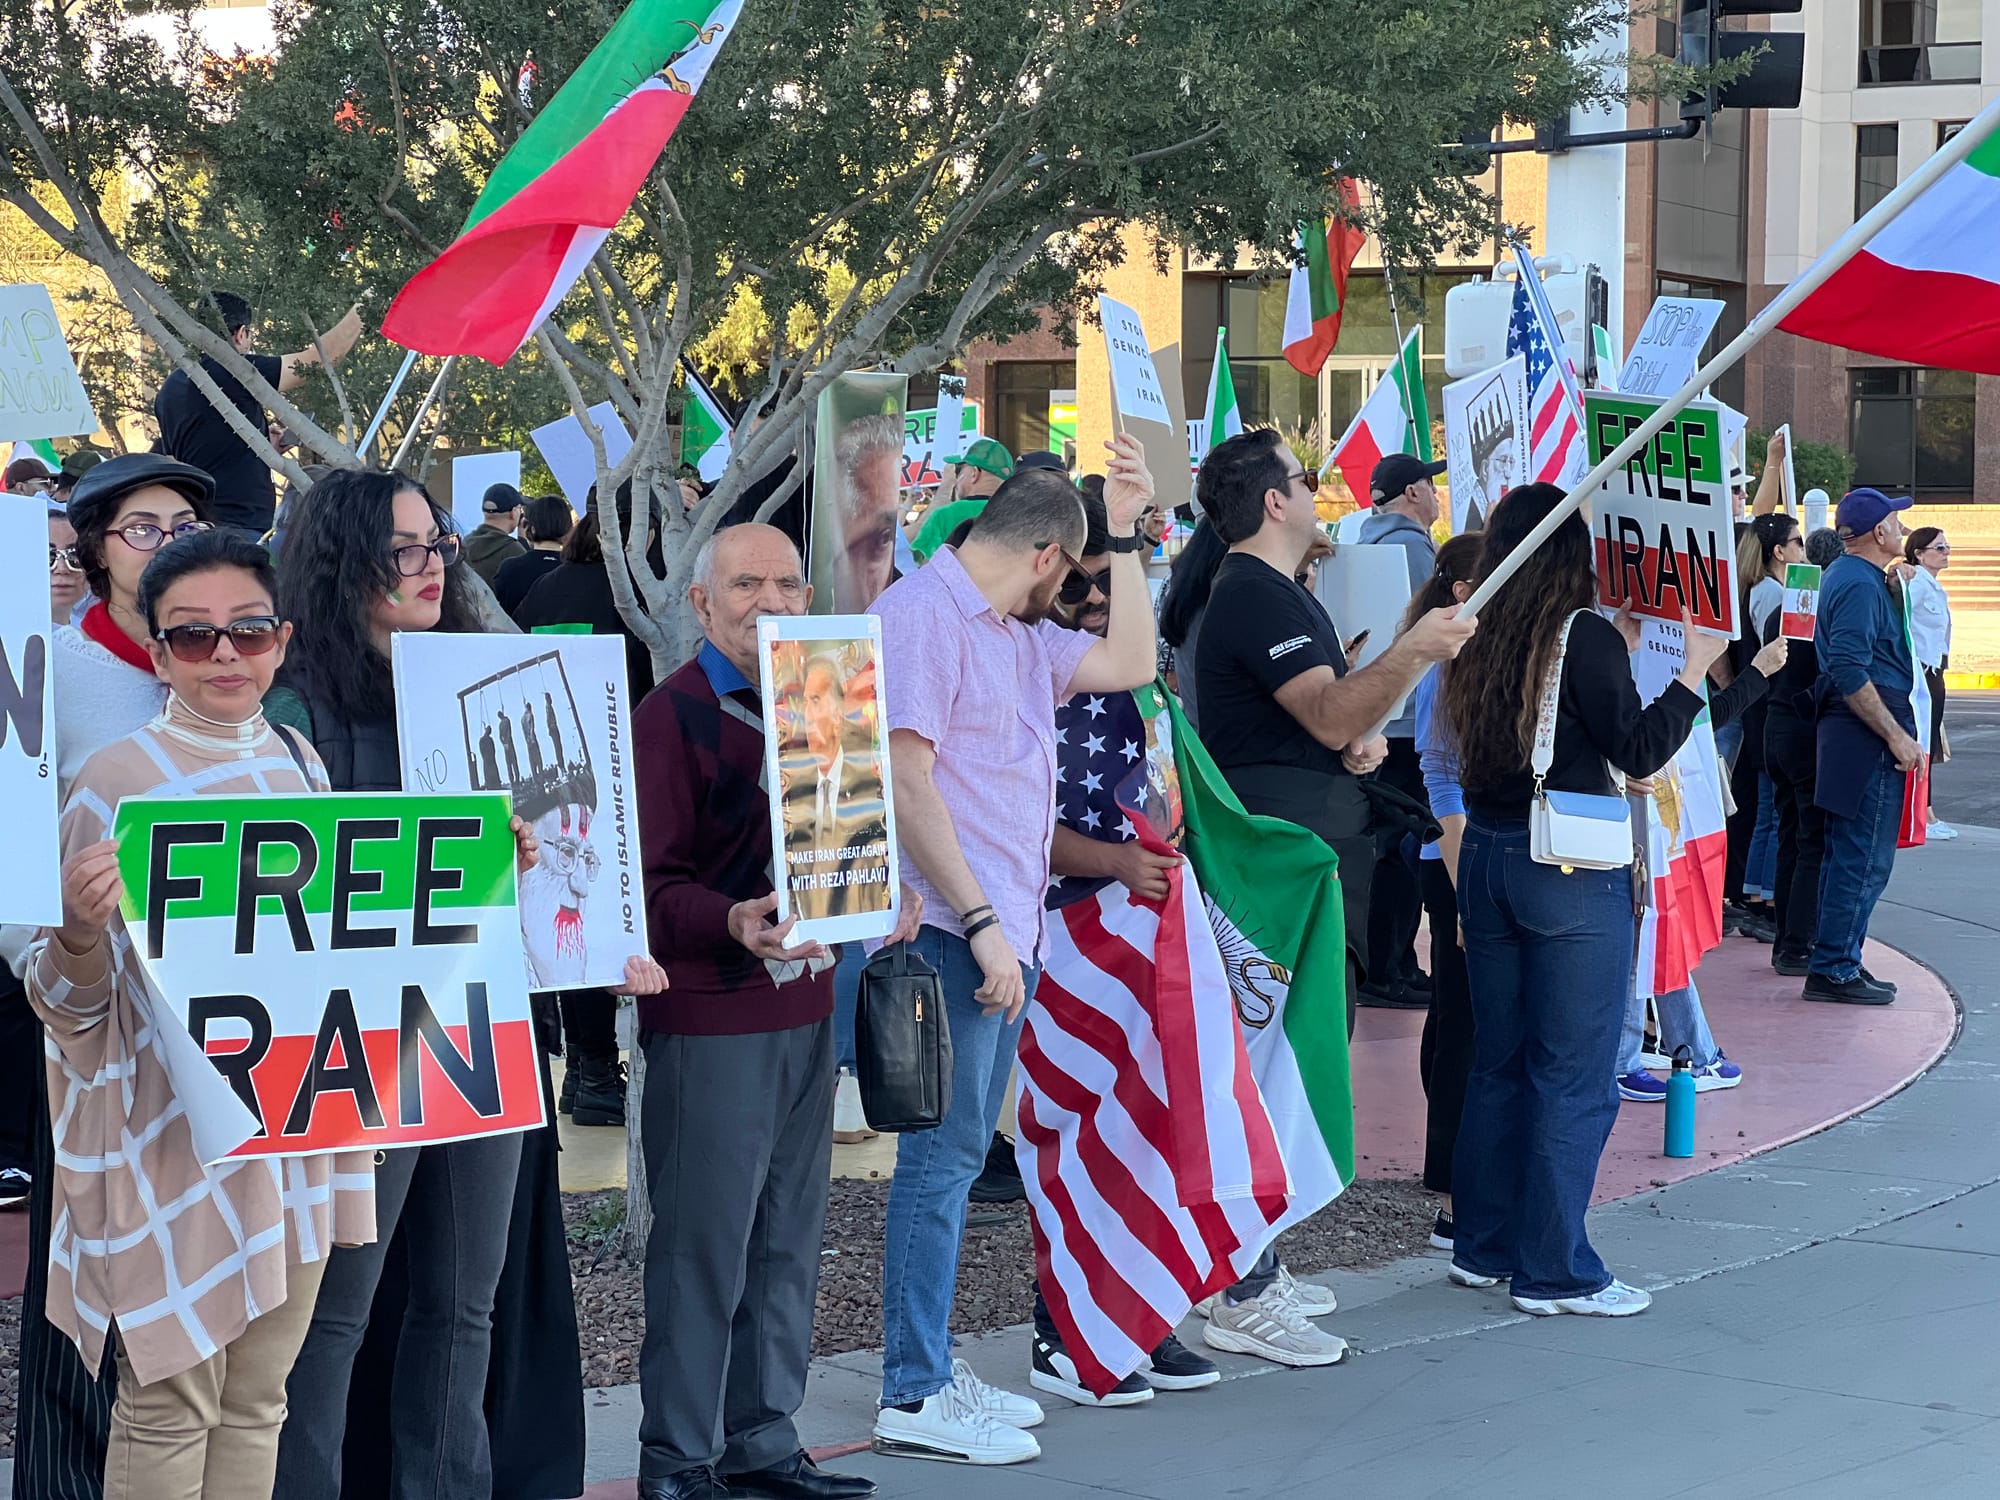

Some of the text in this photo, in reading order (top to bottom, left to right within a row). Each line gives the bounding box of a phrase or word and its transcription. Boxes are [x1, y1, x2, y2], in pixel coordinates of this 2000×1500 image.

[1641, 303, 1694, 347] STOP
[1139, 367, 1151, 381] IN
[1137, 387, 1162, 406] IRAN
[1597, 412, 1712, 506] FREE
[1604, 513, 1722, 621] IRAN
[405, 748, 448, 792] NO
[606, 680, 634, 935] NO TO ISLAMIC REPUBLIC
[790, 843, 886, 865] MAKE IRAN GREAT AGAIN
[146, 816, 484, 960] FREE
[791, 866, 887, 892] WITH REZA PAHLAVI
[188, 981, 503, 1138] RAN
